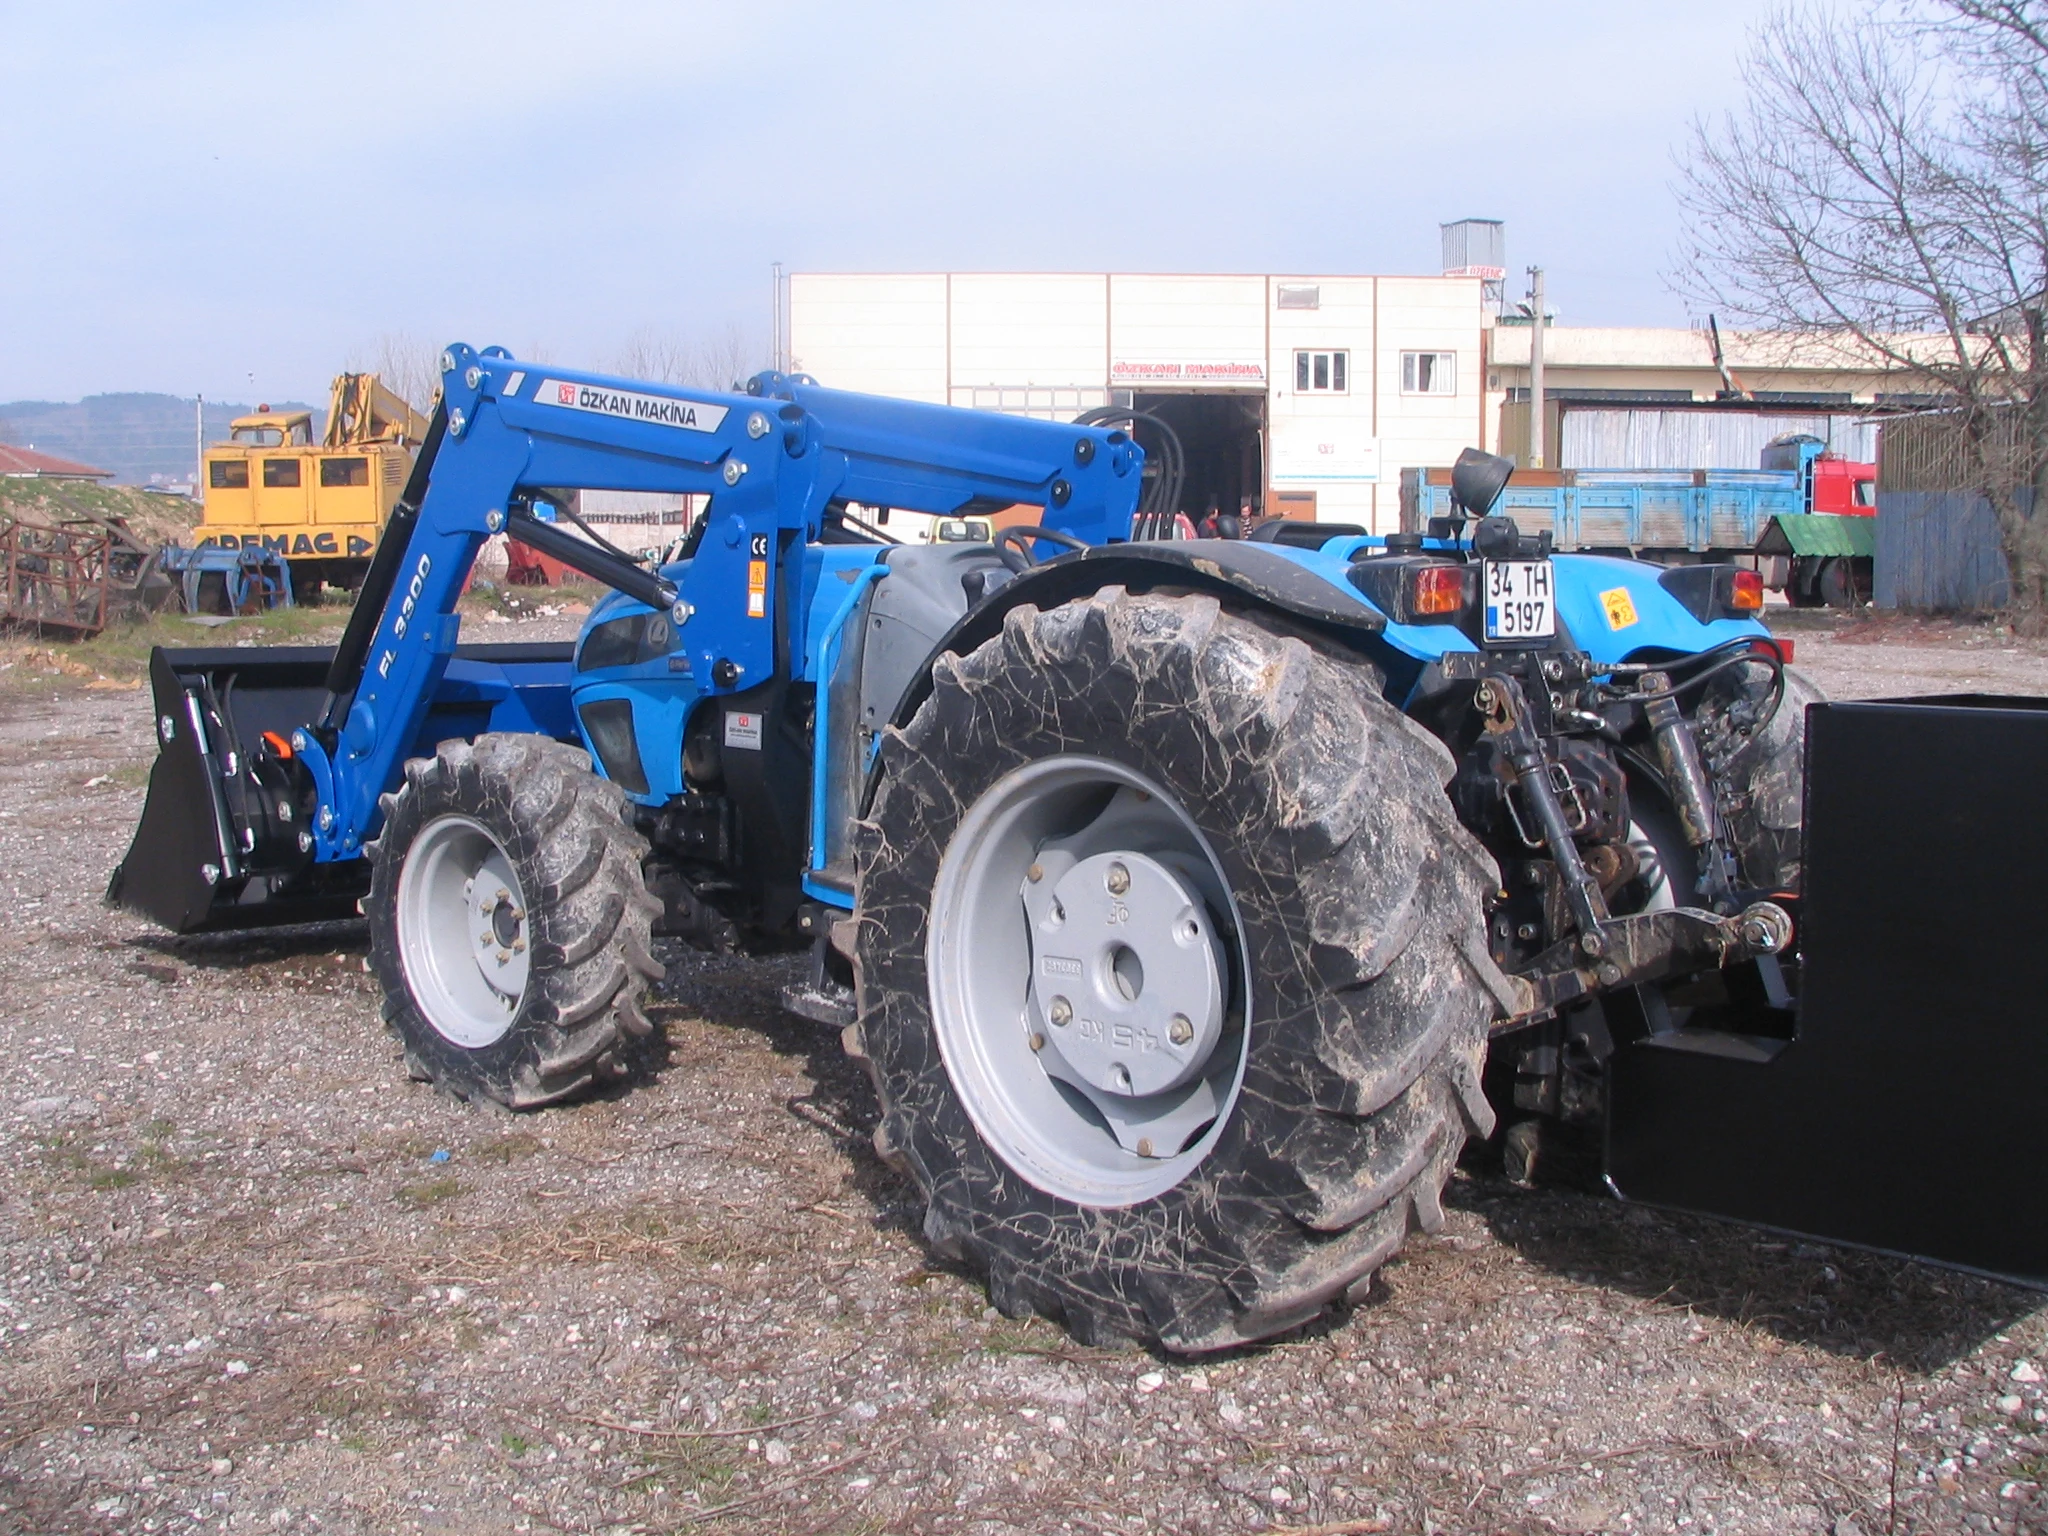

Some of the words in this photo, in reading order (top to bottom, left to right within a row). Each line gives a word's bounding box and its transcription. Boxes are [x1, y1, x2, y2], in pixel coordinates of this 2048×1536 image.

[580, 388, 632, 415] ÖZKAN
[635, 400, 698, 426] MAKİNA
[752, 537, 767, 555] CE
[1491, 562, 1512, 597] 34
[1524, 565, 1548, 596] TH
[379, 649, 398, 679] FL
[394, 553, 432, 640] 3300
[1505, 602, 1544, 633] 5197
[1080, 1018, 1104, 1042] KG
[1112, 1023, 1158, 1053] 45
